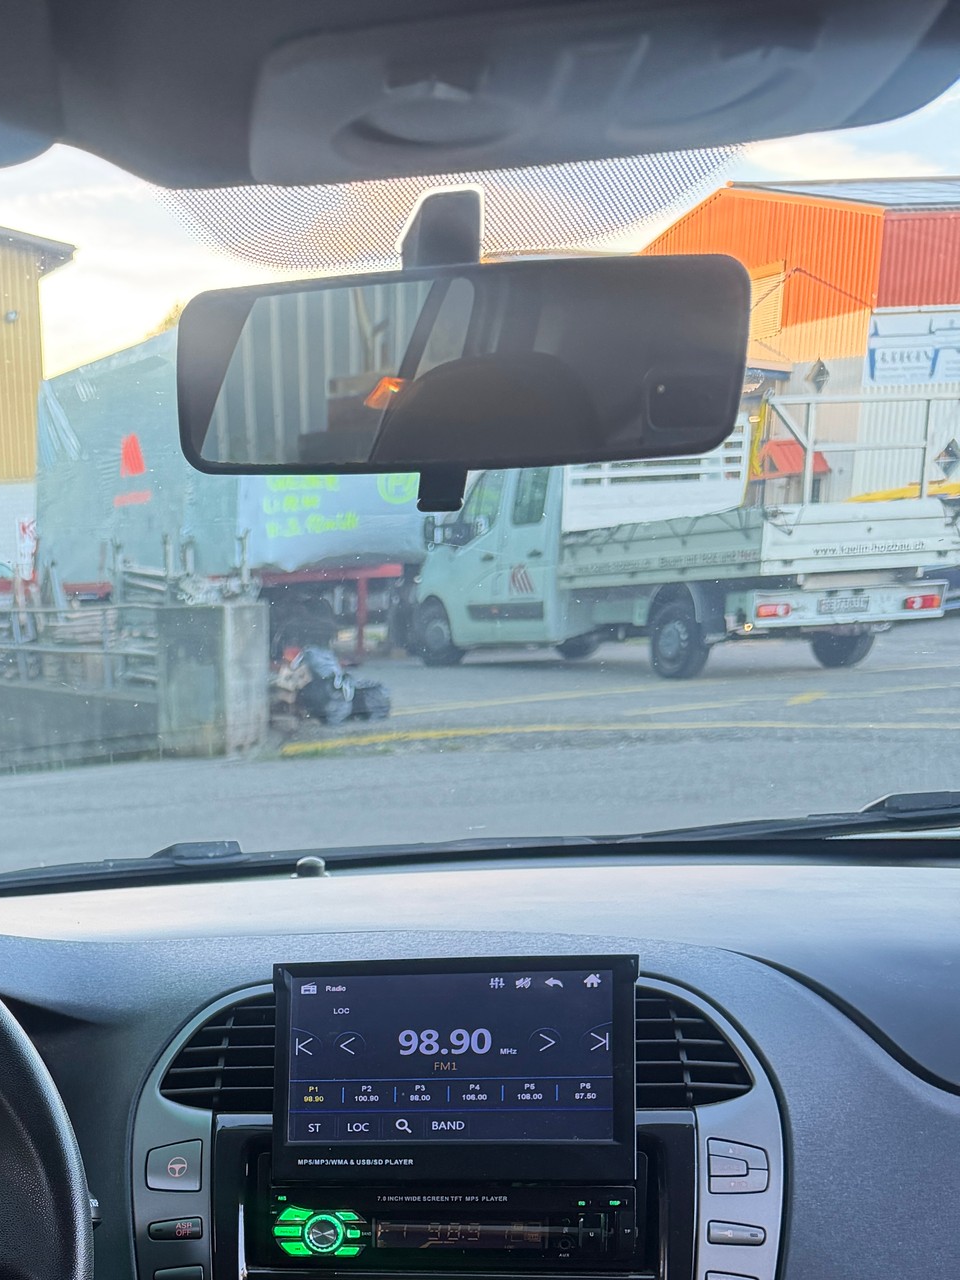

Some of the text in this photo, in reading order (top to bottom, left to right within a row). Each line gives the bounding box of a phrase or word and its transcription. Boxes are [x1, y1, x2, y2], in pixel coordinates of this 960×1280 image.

[333, 1007, 350, 1015] LOC
[398, 1028, 492, 1056] 98.90
[434, 1061, 458, 1071] FM1
[308, 1085, 319, 1093] P1
[469, 1083, 480, 1091] P4
[461, 1093, 488, 1101] 106.00
[574, 1092, 596, 1100] 87.50
[308, 1123, 321, 1133] ST
[347, 1122, 370, 1132] LOC
[431, 1121, 465, 1131] BAND
[297, 1158, 348, 1166] MP5/MP3/WMA
[384, 1158, 414, 1166] PLAYER
[175, 1229, 192, 1237] OFF
